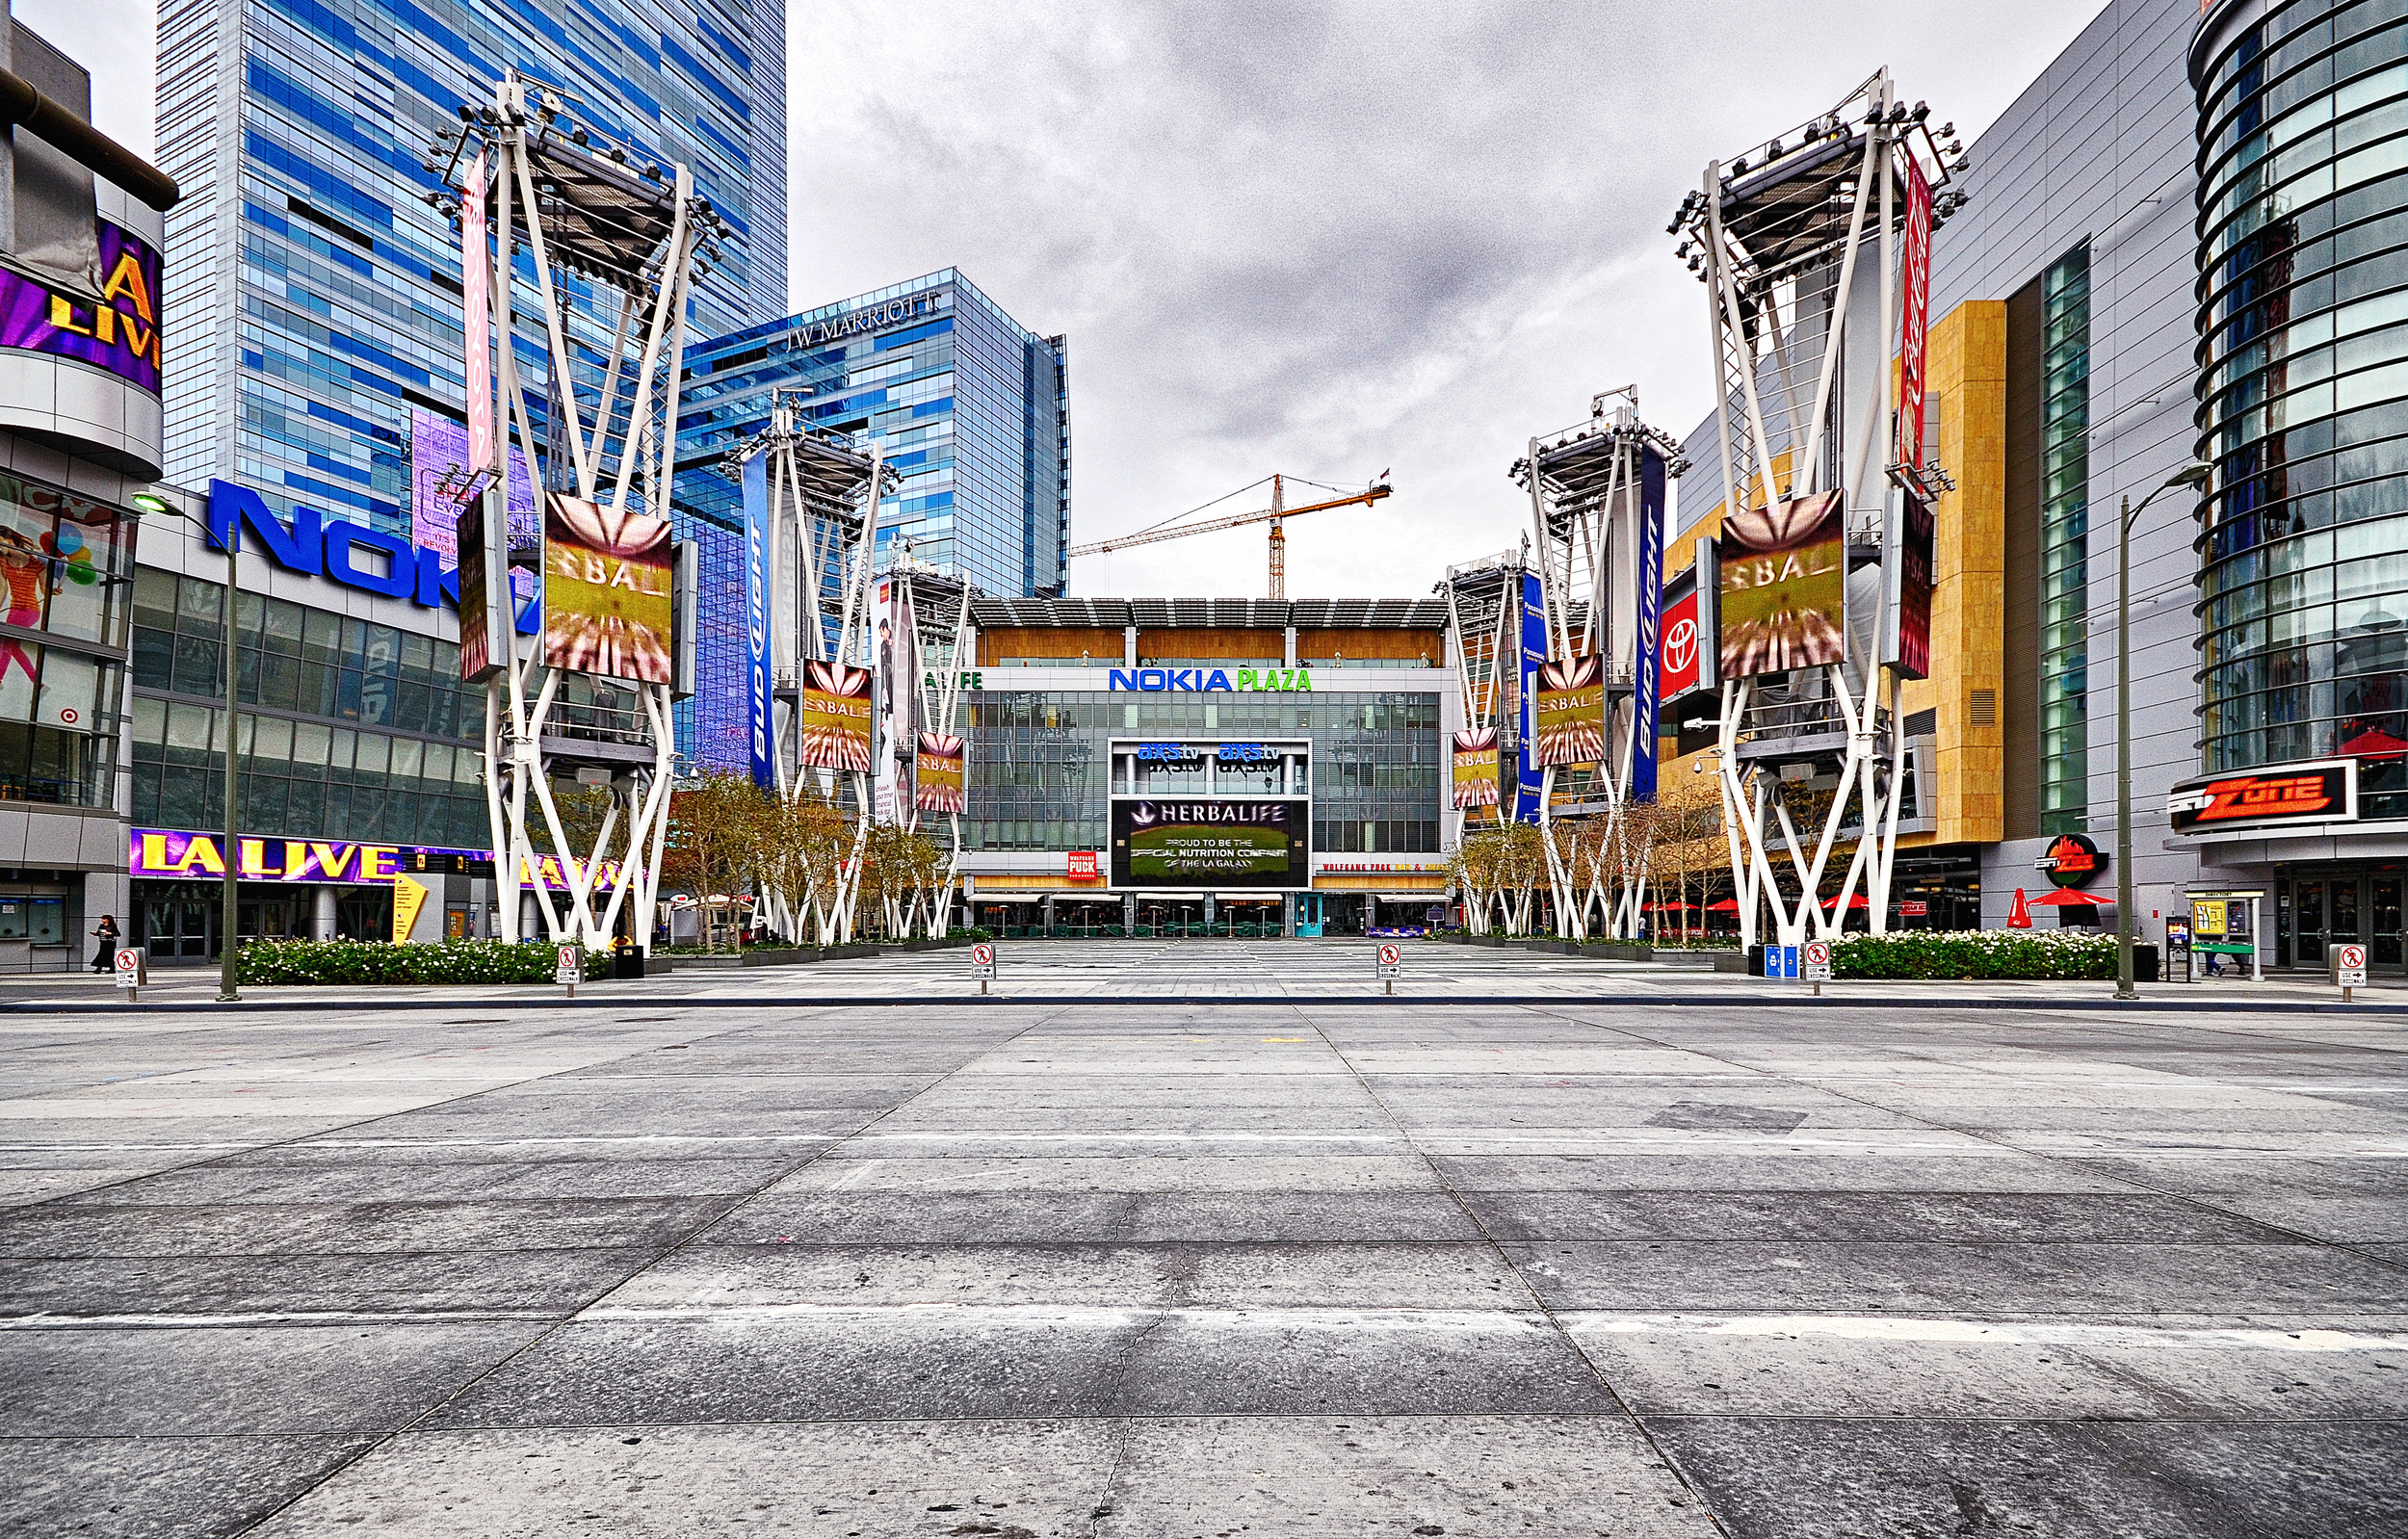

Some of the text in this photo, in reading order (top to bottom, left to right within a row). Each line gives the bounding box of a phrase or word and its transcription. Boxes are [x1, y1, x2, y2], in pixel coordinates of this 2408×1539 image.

[820, 289, 937, 342] MARRIOTT
[470, 257, 485, 457] TOYOTA
[750, 517, 766, 762] BUD LIGHT
[1639, 504, 1661, 759] BUD LIGHT
[1109, 669, 1312, 691] NOKIA PLAZA
[1162, 804, 1287, 822] HERBALIFE
[142, 833, 399, 880] LA LIVE
[1179, 848, 1235, 857] NUTRITION
[1202, 839, 1216, 848] TO
[1217, 839, 1232, 848] BE
[1069, 861, 1095, 873] PUCK
